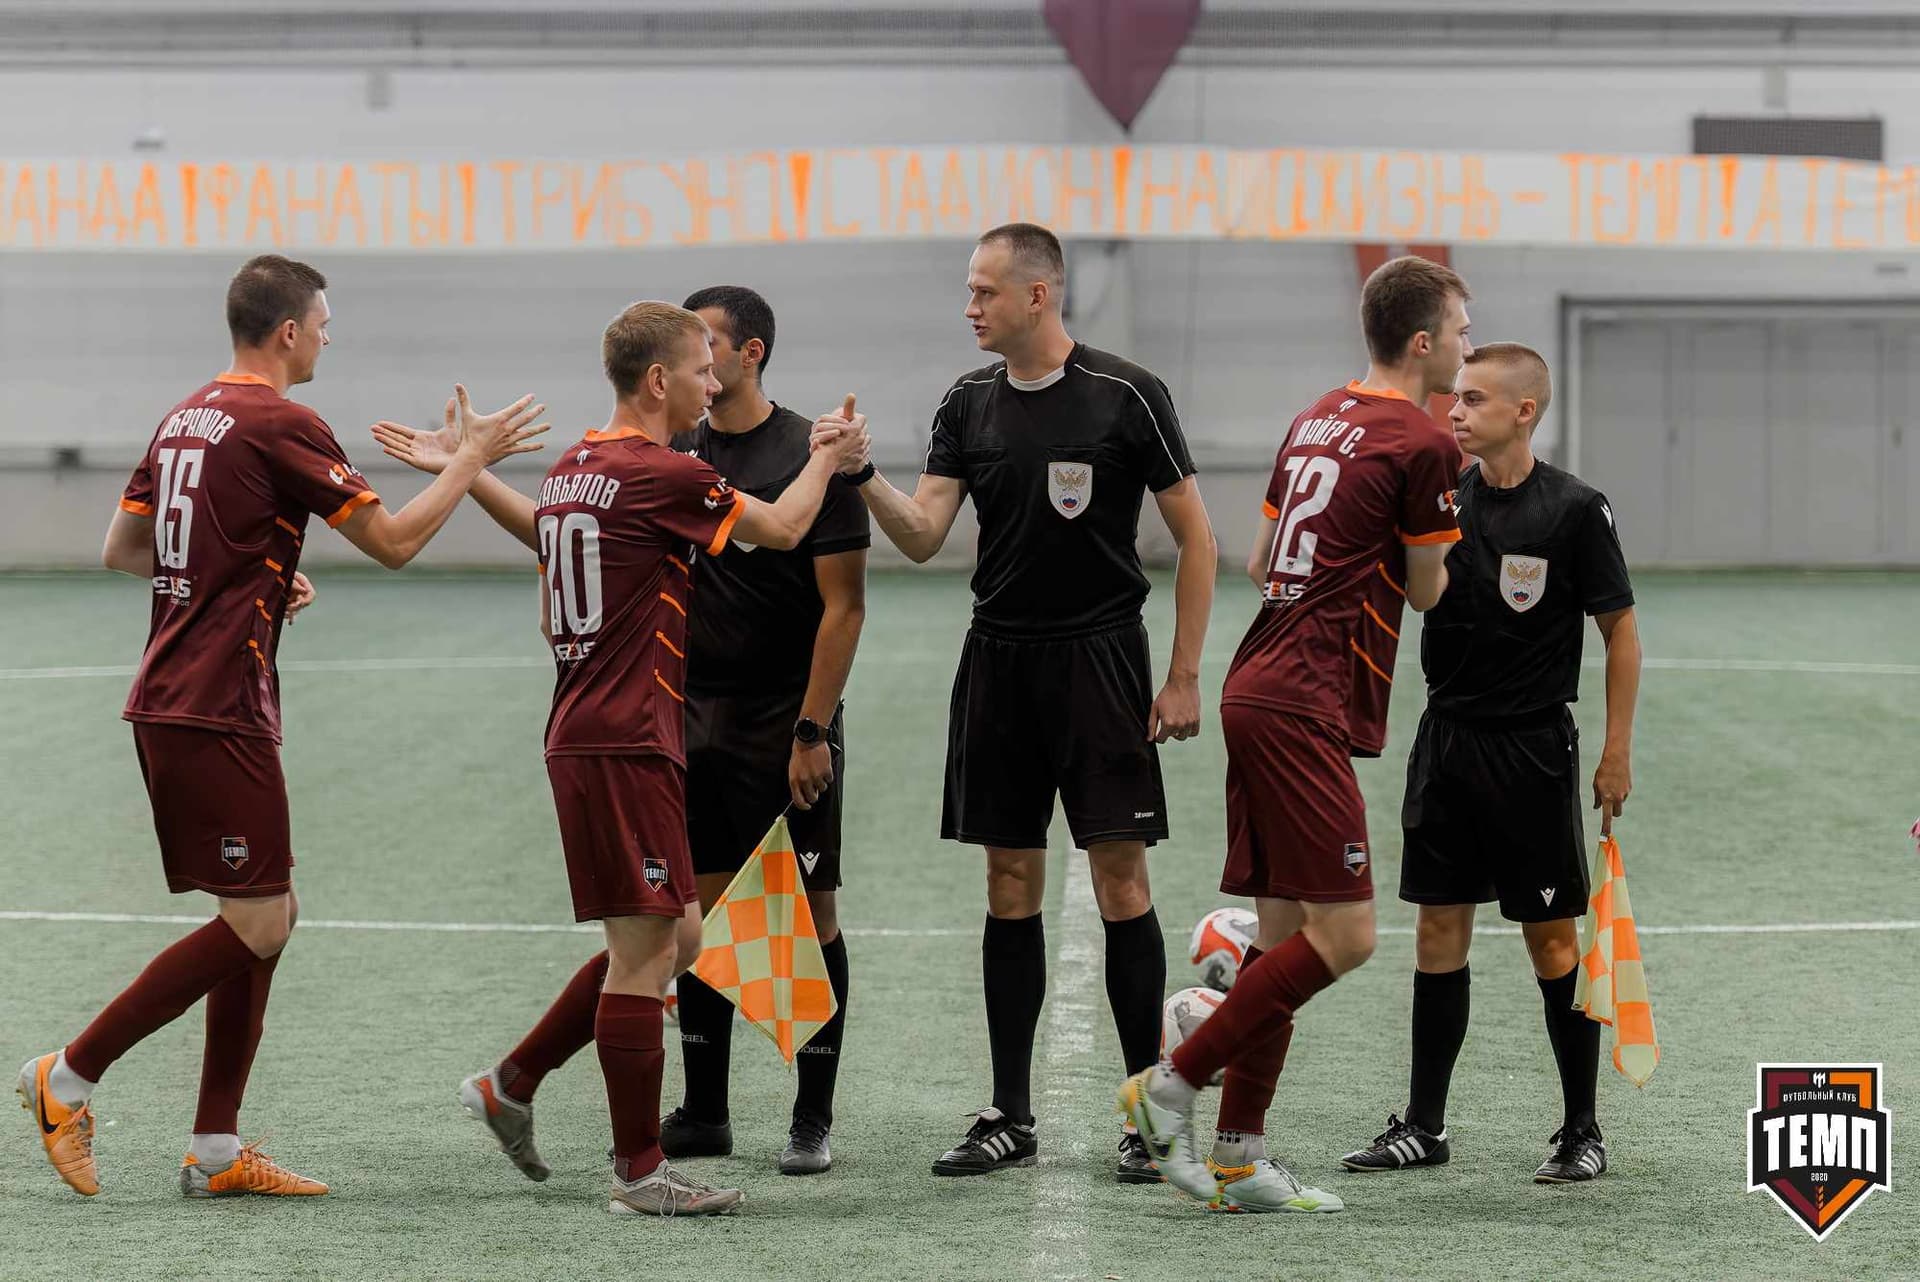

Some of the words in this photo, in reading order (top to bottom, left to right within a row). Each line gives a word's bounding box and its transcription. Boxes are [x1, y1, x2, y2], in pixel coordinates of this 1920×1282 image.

[0, 160, 200, 248] АНДА!
[538, 512, 602, 636] 20
[1266, 455, 1341, 577] 12
